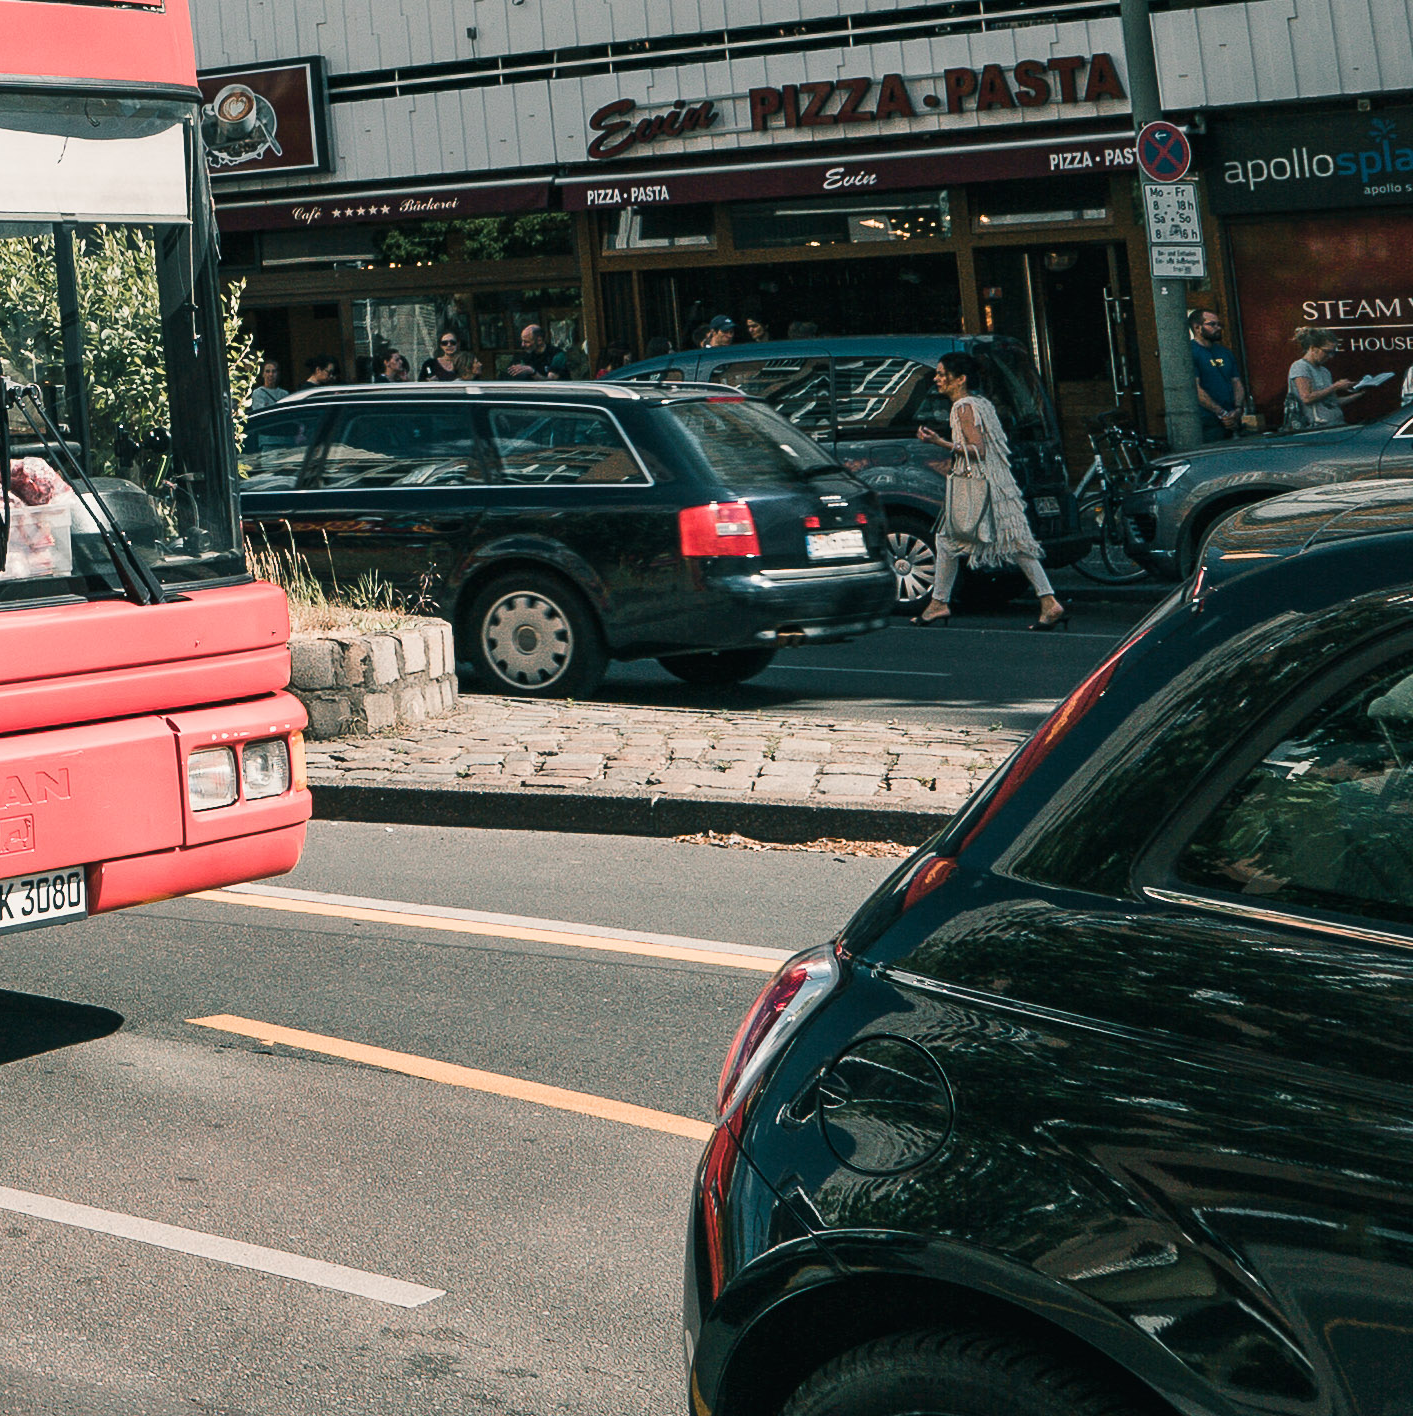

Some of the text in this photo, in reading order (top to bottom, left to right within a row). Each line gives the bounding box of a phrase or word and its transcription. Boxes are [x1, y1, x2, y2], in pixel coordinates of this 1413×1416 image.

[587, 51, 1129, 160] Evin PIZZA PASTA
[1049, 151, 1093, 171] PIZZA
[822, 166, 878, 190] Evin
[586, 184, 670, 206] PIZZA PASTA
[1149, 187, 1164, 198] Mo
[1175, 186, 1186, 197] Fr
[1364, 184, 1402, 197] apollo
[291, 196, 460, 225] Café Bäckerei
[1153, 200, 1159, 210] 8
[1177, 200, 1186, 211] 18
[1188, 200, 1194, 210] h
[1153, 213, 1191, 224] Sa So
[1156, 229, 1162, 239] 8
[1191, 229, 1197, 239] h
[1302, 297, 1402, 321] STEAM
[1350, 336, 1413, 352] HOUSE
[21, 871, 82, 917] 3080
